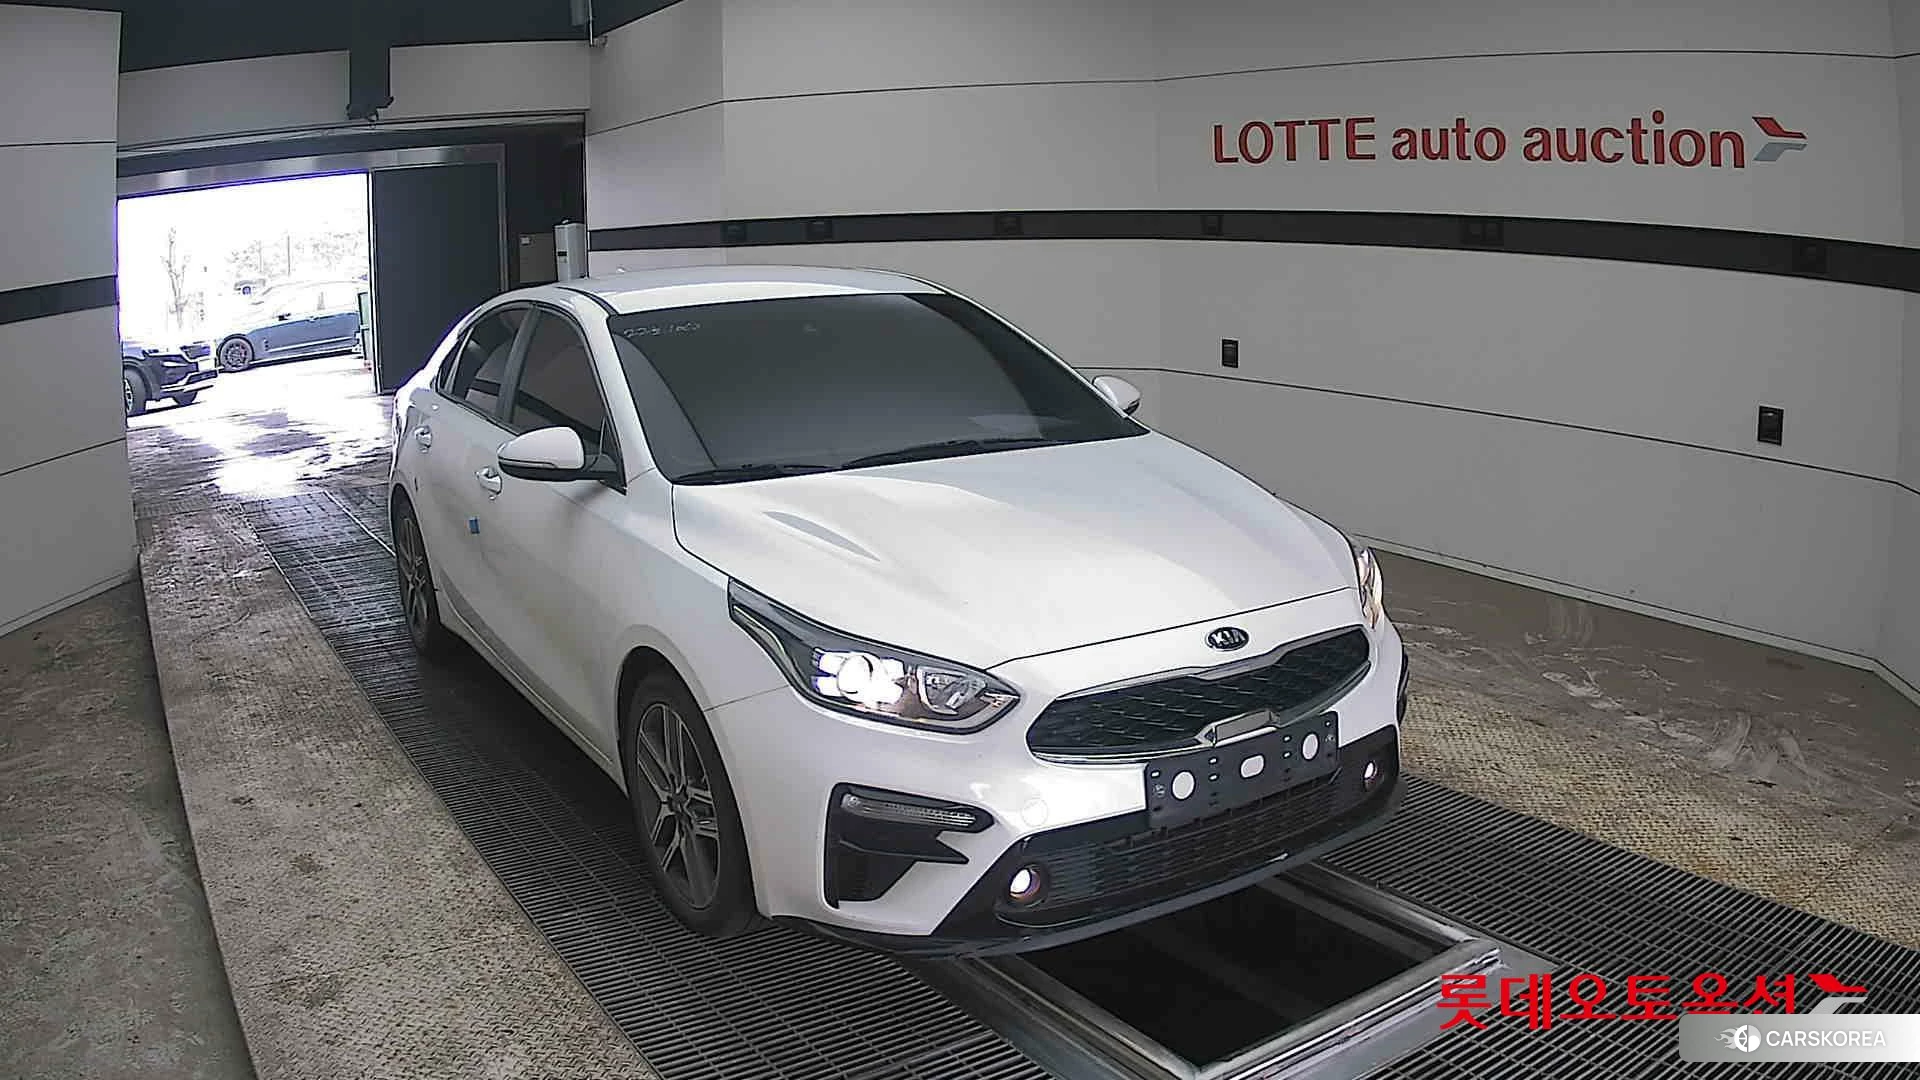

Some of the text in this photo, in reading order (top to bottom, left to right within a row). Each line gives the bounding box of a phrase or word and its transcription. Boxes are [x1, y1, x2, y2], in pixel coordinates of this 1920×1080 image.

[1213, 110, 1746, 169] LOTTE auto auction
[1208, 628, 1248, 647] KIA
